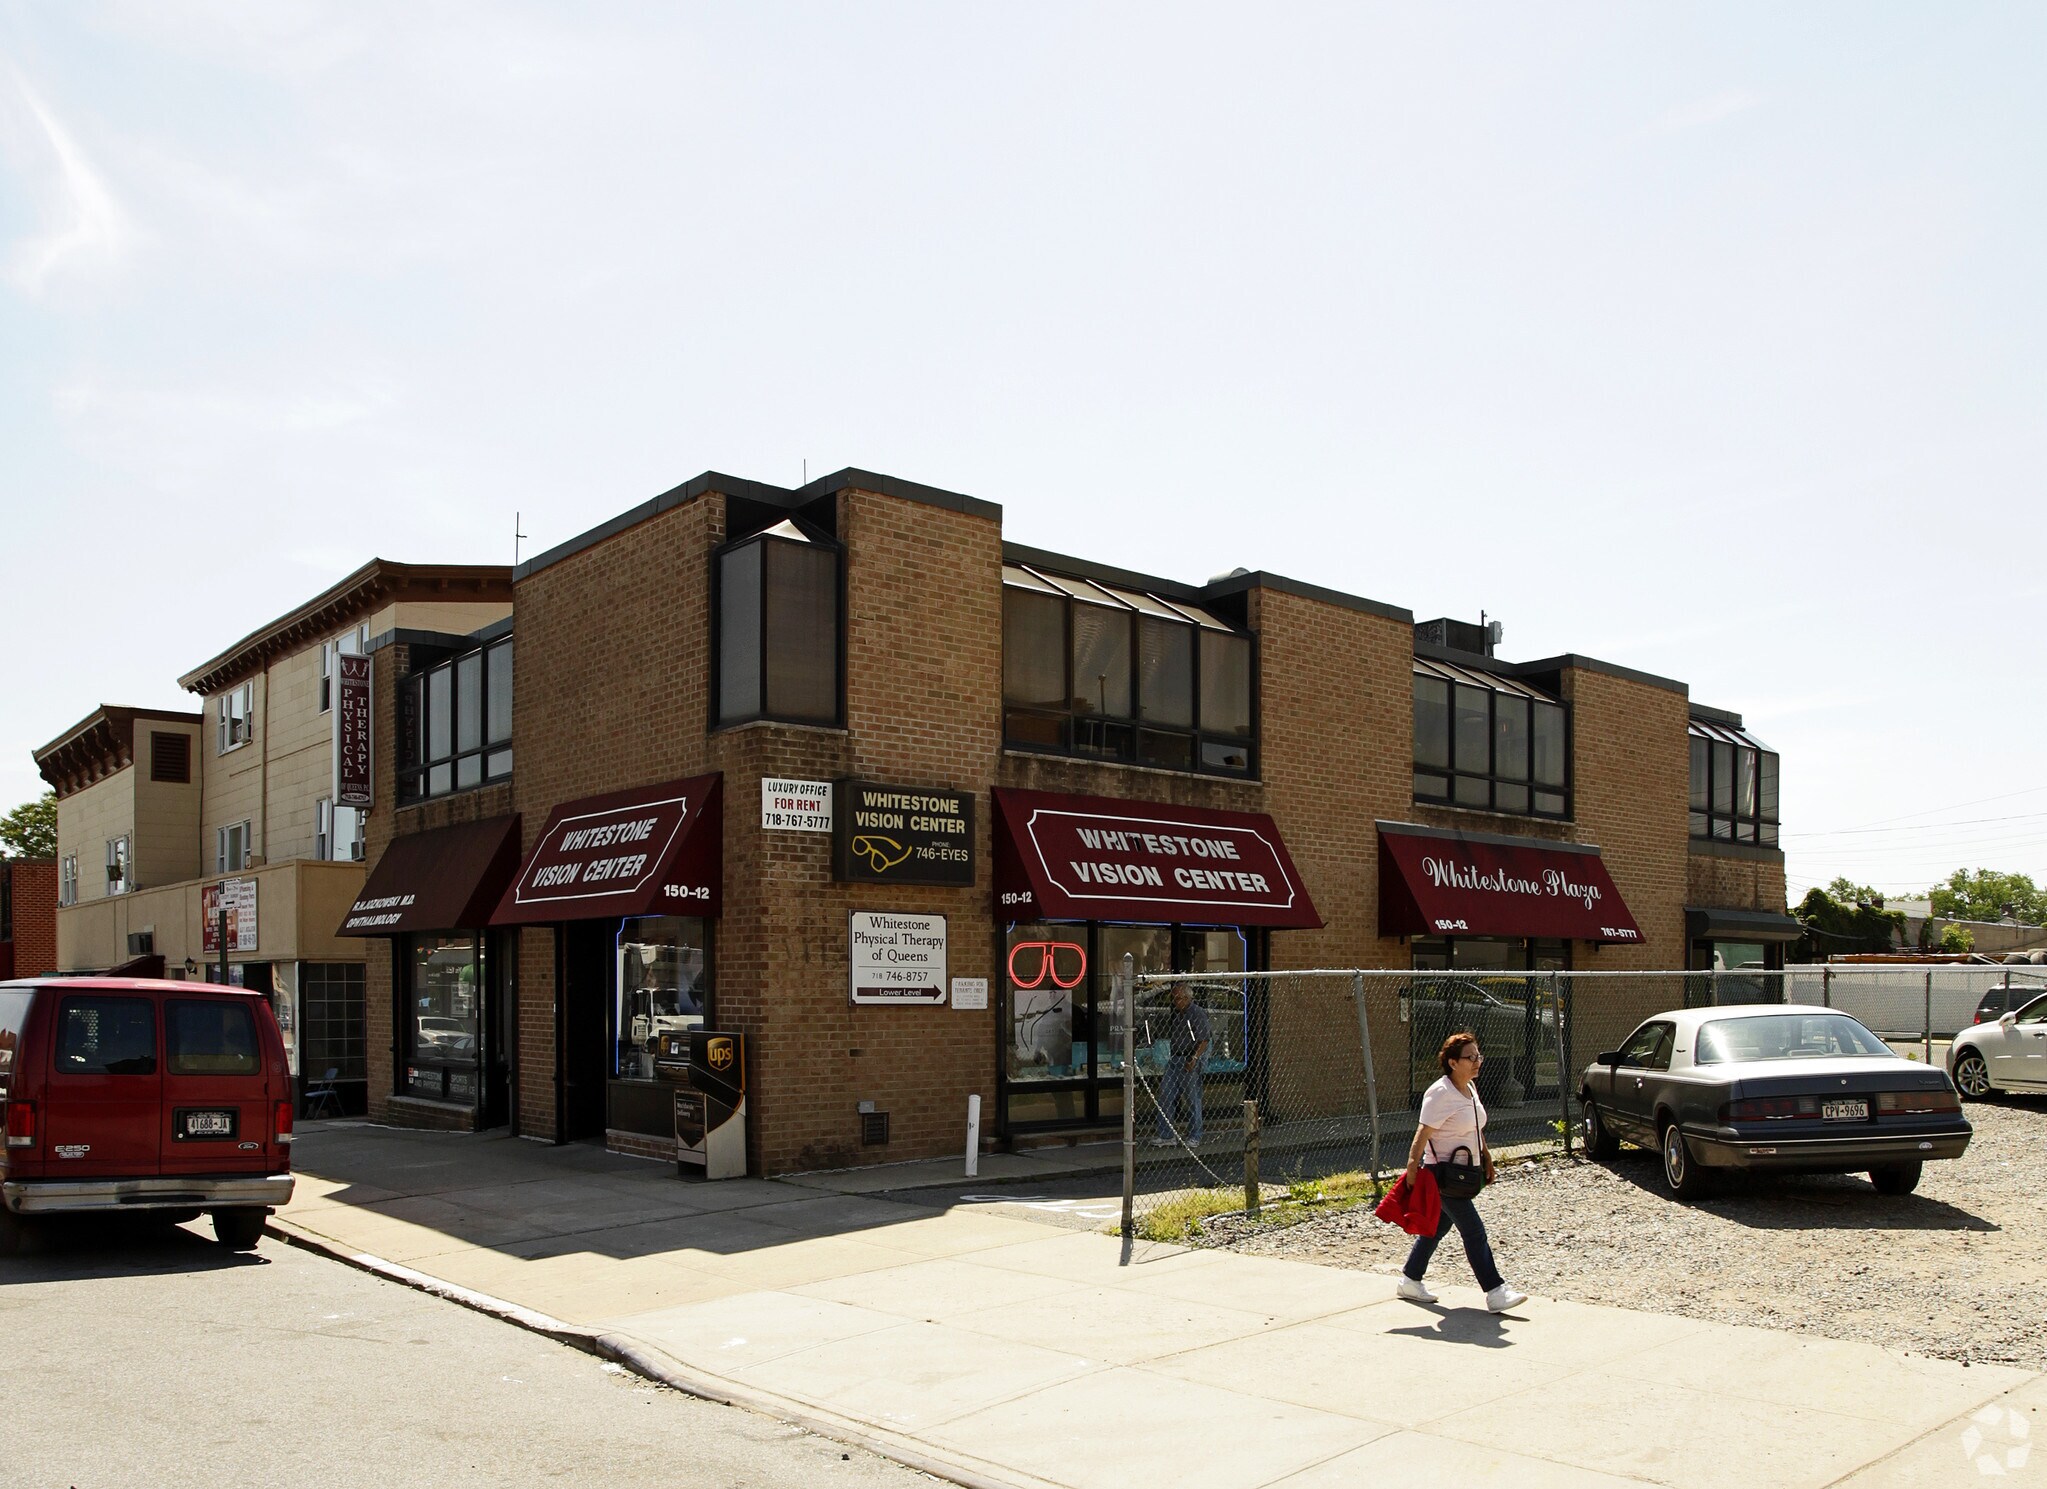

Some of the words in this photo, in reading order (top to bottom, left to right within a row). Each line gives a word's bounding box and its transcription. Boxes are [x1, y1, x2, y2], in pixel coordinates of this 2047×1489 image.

[343, 688, 354, 778] PHYSICAL
[357, 696, 368, 775] THERAPY
[767, 782, 799, 795] LUXURY
[800, 785, 828, 796] OFFICE
[774, 797, 794, 810] FOR
[797, 799, 821, 812] RENT
[863, 791, 959, 814] WHITESTONE
[765, 813, 830, 829] 718-767-5777
[856, 811, 904, 830] VISION
[910, 815, 966, 834] CENTER
[560, 817, 658, 852] WHITESTONE
[1076, 827, 1241, 861] WHITESTONE
[916, 847, 969, 862] 746-EYES
[531, 862, 582, 889] VISION
[582, 853, 647, 881] CENTER
[1070, 861, 1163, 887] VISION
[1173, 867, 1271, 894] CENTER
[1421, 856, 1542, 896] Whitestone
[1542, 868, 1602, 910] Plaza
[663, 884, 710, 900] 150-12
[1001, 891, 1032, 905] 150-12
[346, 913, 402, 928] OPHTHALMOLOGY
[870, 916, 931, 931] Whitestone
[1435, 919, 1468, 930] 150-12
[854, 932, 898, 949] Physical
[901, 933, 944, 950] Therapy
[1600, 927, 1637, 939] 767-5777
[871, 948, 883, 962] of
[887, 949, 928, 964] Queens
[886, 971, 928, 982] 746-8757
[879, 988, 901, 997] Lower
[903, 988, 922, 997] Level
[710, 1048, 731, 1066] ups
